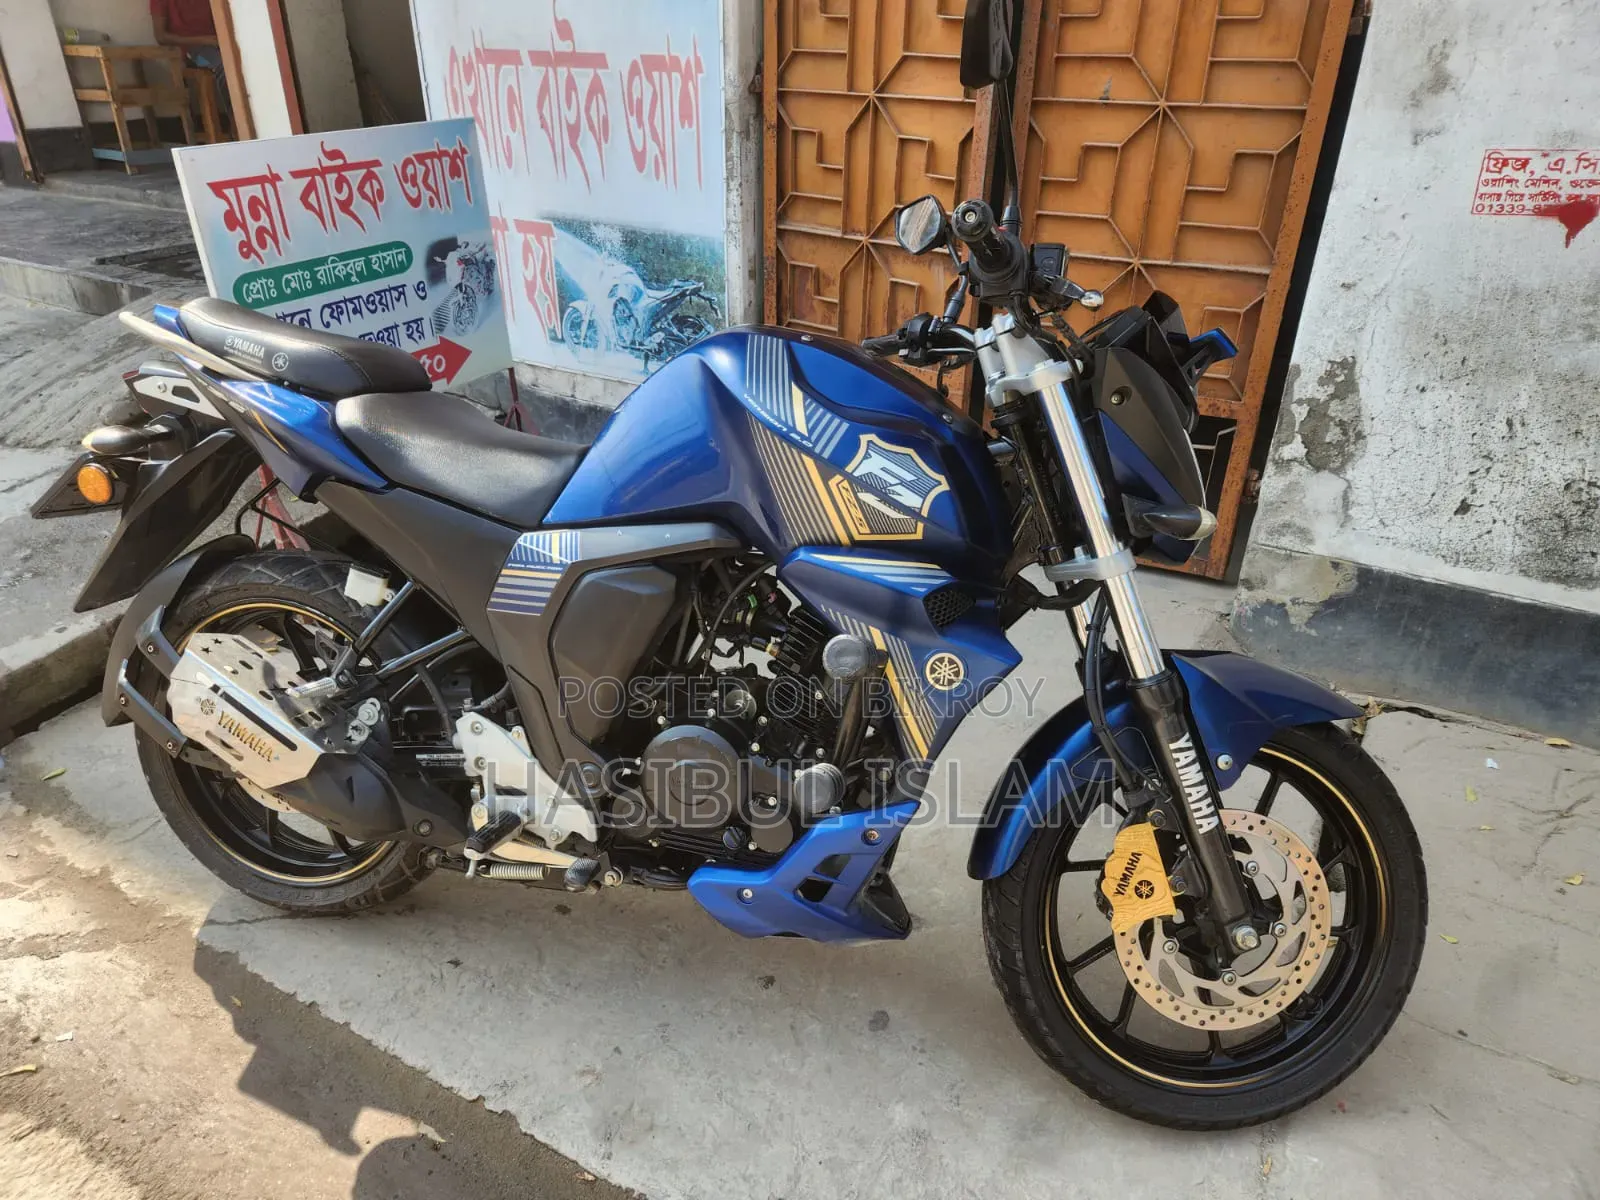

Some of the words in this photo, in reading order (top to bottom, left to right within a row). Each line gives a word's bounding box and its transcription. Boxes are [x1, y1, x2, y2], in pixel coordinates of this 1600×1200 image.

[527, 0, 610, 195] বাইক
[620, 33, 705, 194] ওয়াশ
[206, 163, 292, 265] মুন্না
[288, 140, 385, 234] বাইক
[393, 136, 473, 211] ওয়াশ
[282, 267, 313, 295] মোঃ
[313, 256, 367, 285] রাকিবুল
[368, 248, 408, 275] হাসান
[412, 280, 428, 301] ও
[217, 710, 274, 763] YAMAHA
[1168, 731, 1220, 835] YAMAHA
[1114, 851, 1143, 898] YAMAHA
